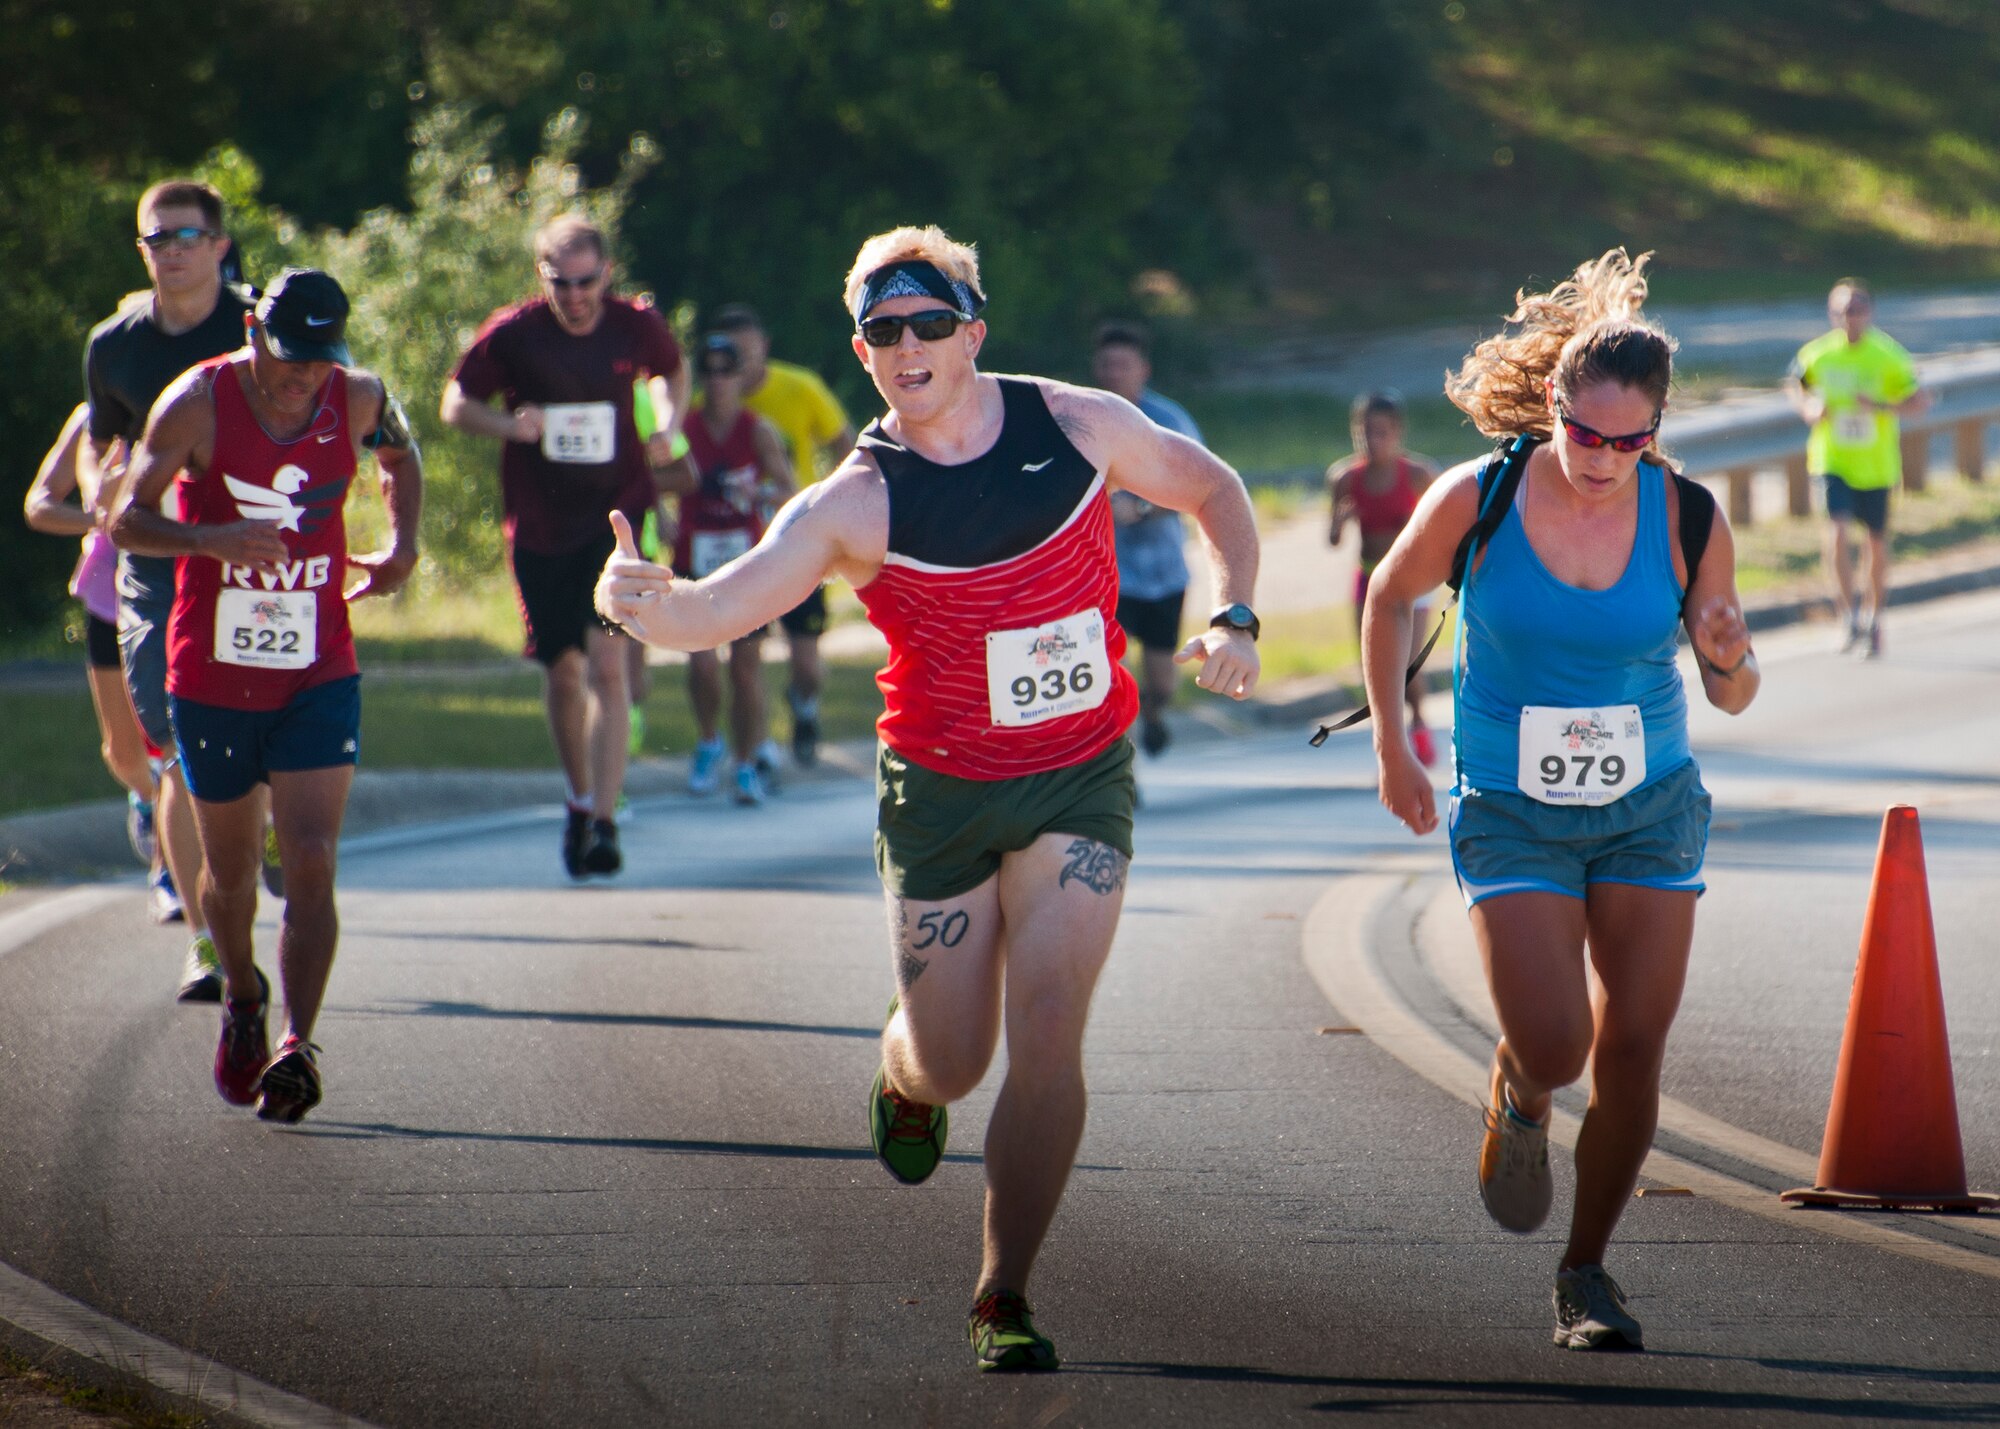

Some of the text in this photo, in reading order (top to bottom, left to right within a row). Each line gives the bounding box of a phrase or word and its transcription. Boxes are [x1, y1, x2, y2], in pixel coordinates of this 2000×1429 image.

[232, 627, 300, 654] 522
[1011, 662, 1093, 706] 936
[1540, 755, 1626, 787] 979
[912, 909, 970, 950] 50
